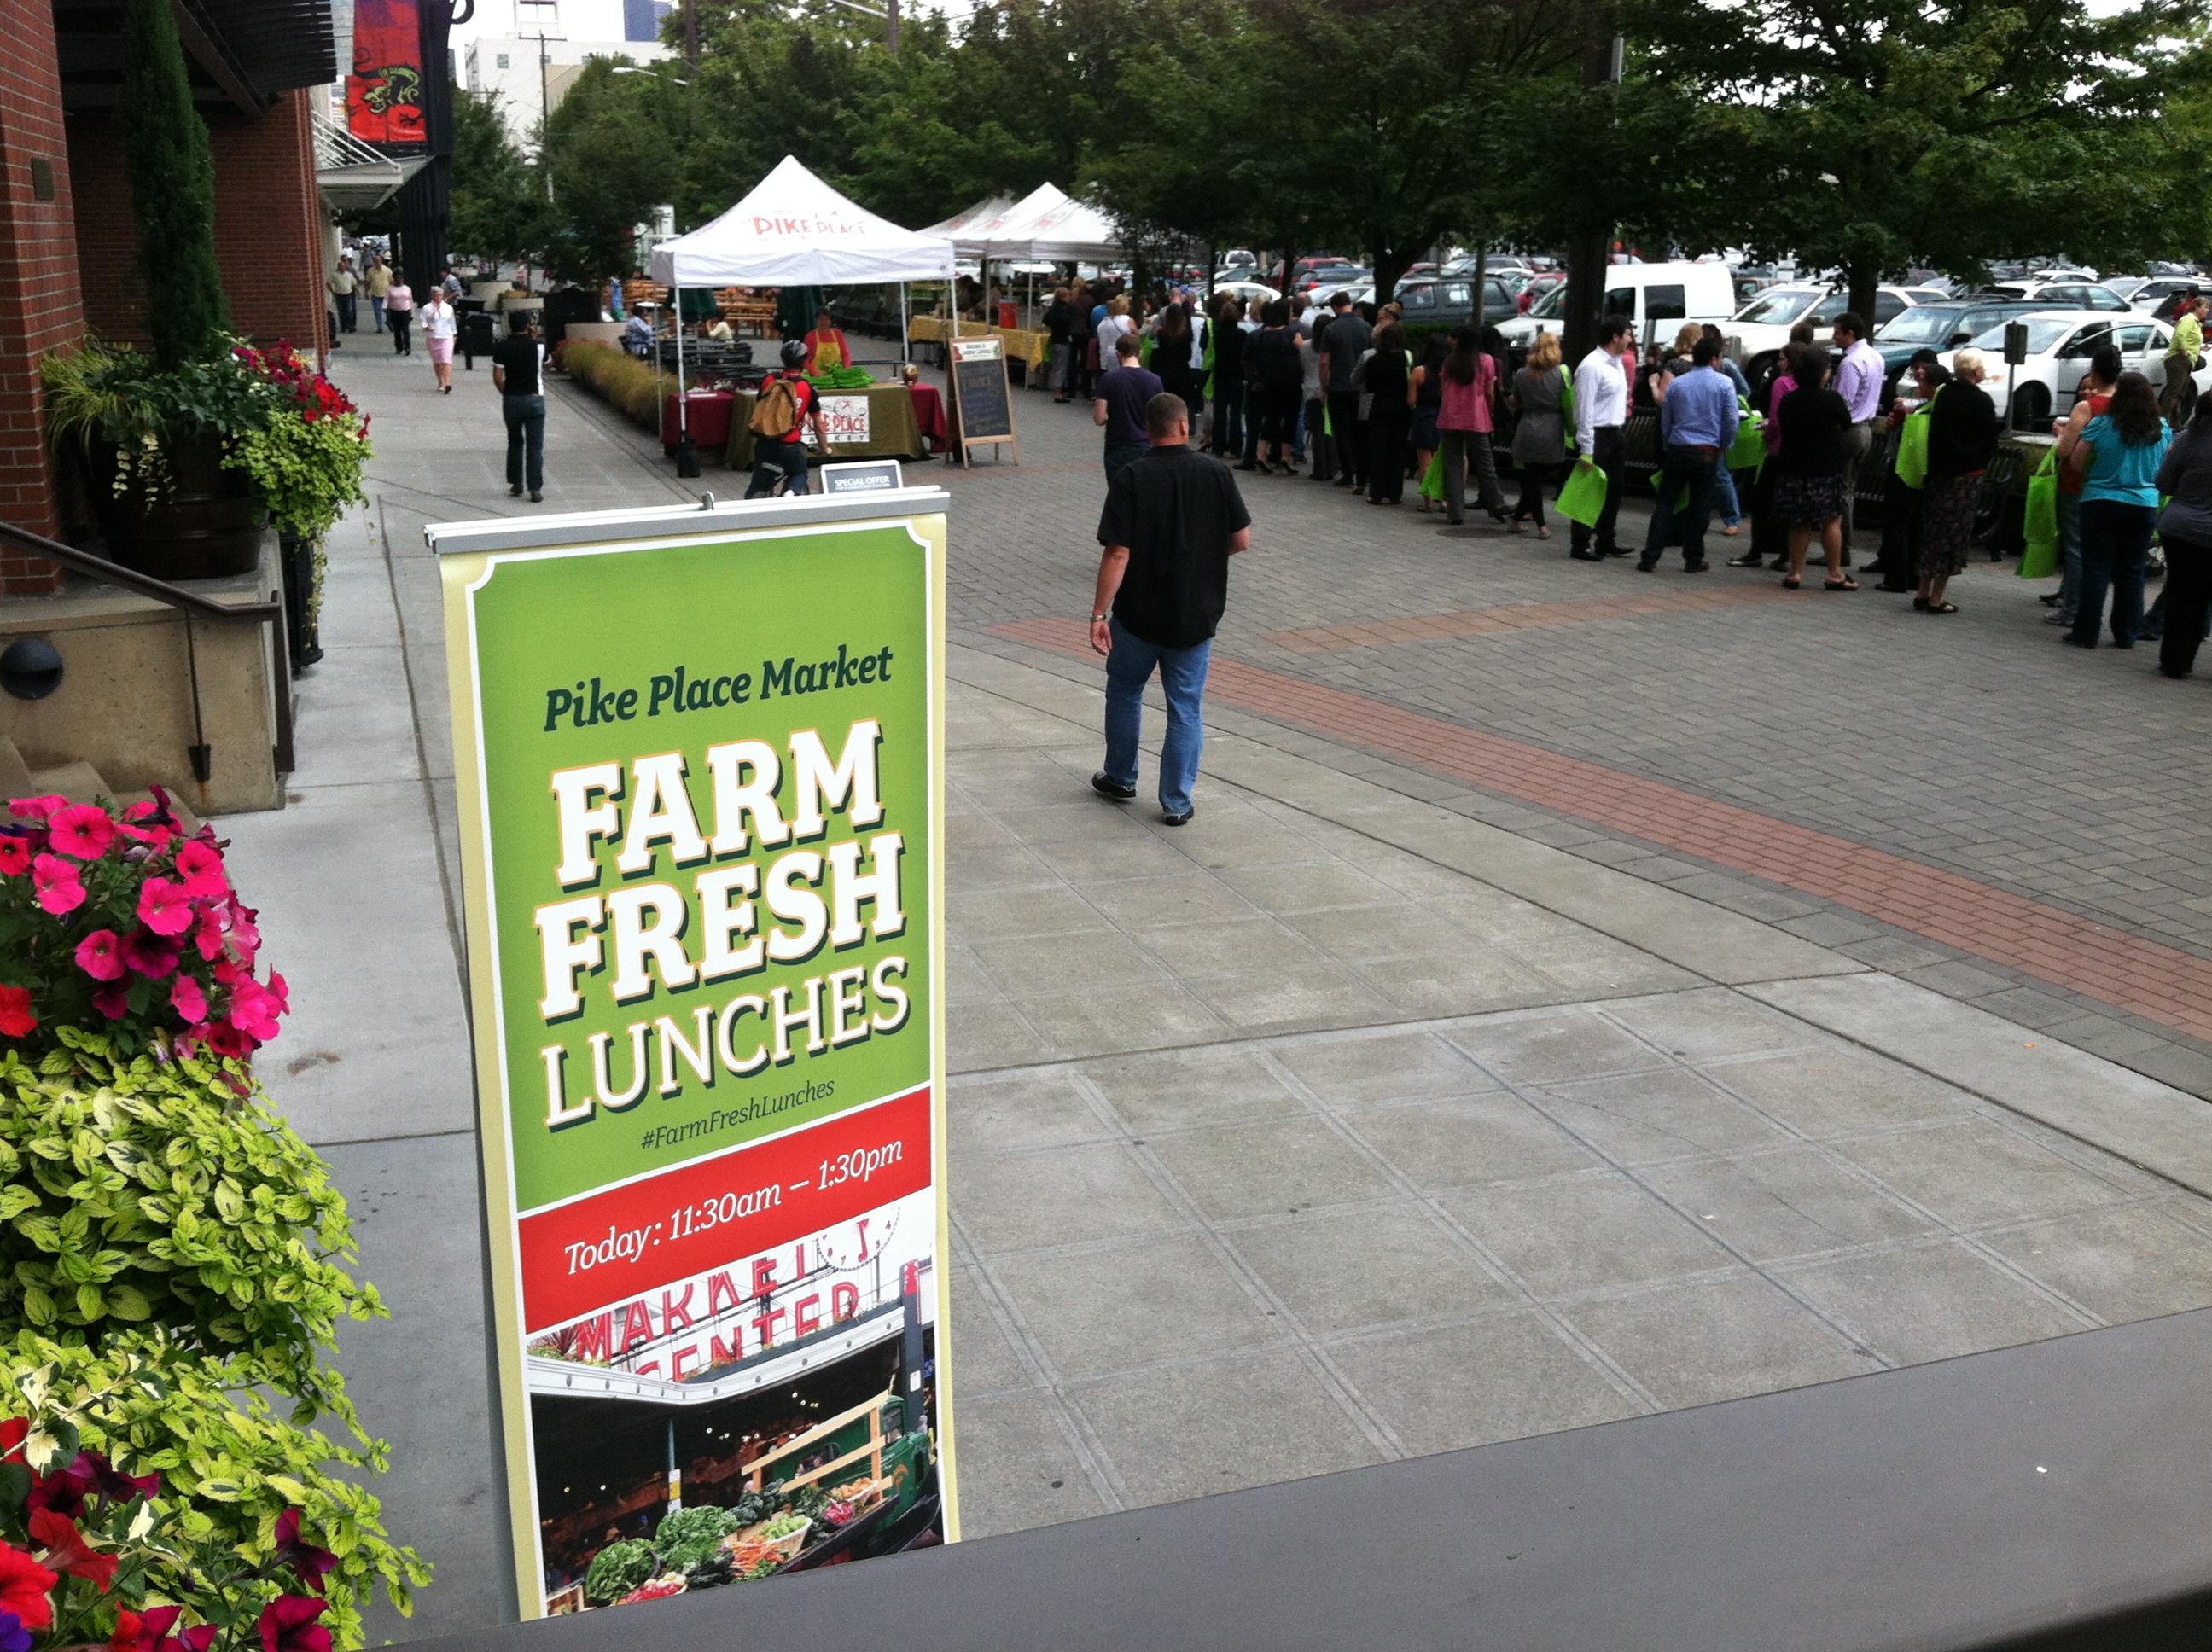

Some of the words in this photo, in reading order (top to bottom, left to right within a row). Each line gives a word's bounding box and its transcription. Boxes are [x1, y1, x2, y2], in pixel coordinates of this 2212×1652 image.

[753, 216, 812, 236] PIKE
[816, 220, 865, 235] PLACE
[833, 415, 864, 432] PLACE
[835, 477, 865, 487] SPECIAL
[865, 475, 890, 484] OFFER
[544, 677, 638, 732] Pike
[647, 665, 752, 717] Place
[760, 643, 894, 700] Market
[550, 718, 884, 893] FARM
[533, 831, 907, 1026] FRESH
[539, 956, 911, 1133] LUNCHES
[641, 1079, 835, 1150] #FarmFreshLunches
[564, 1221, 661, 1276] Today:
[669, 1182, 782, 1241] 11:30am
[818, 1140, 903, 1191] 1:30pm
